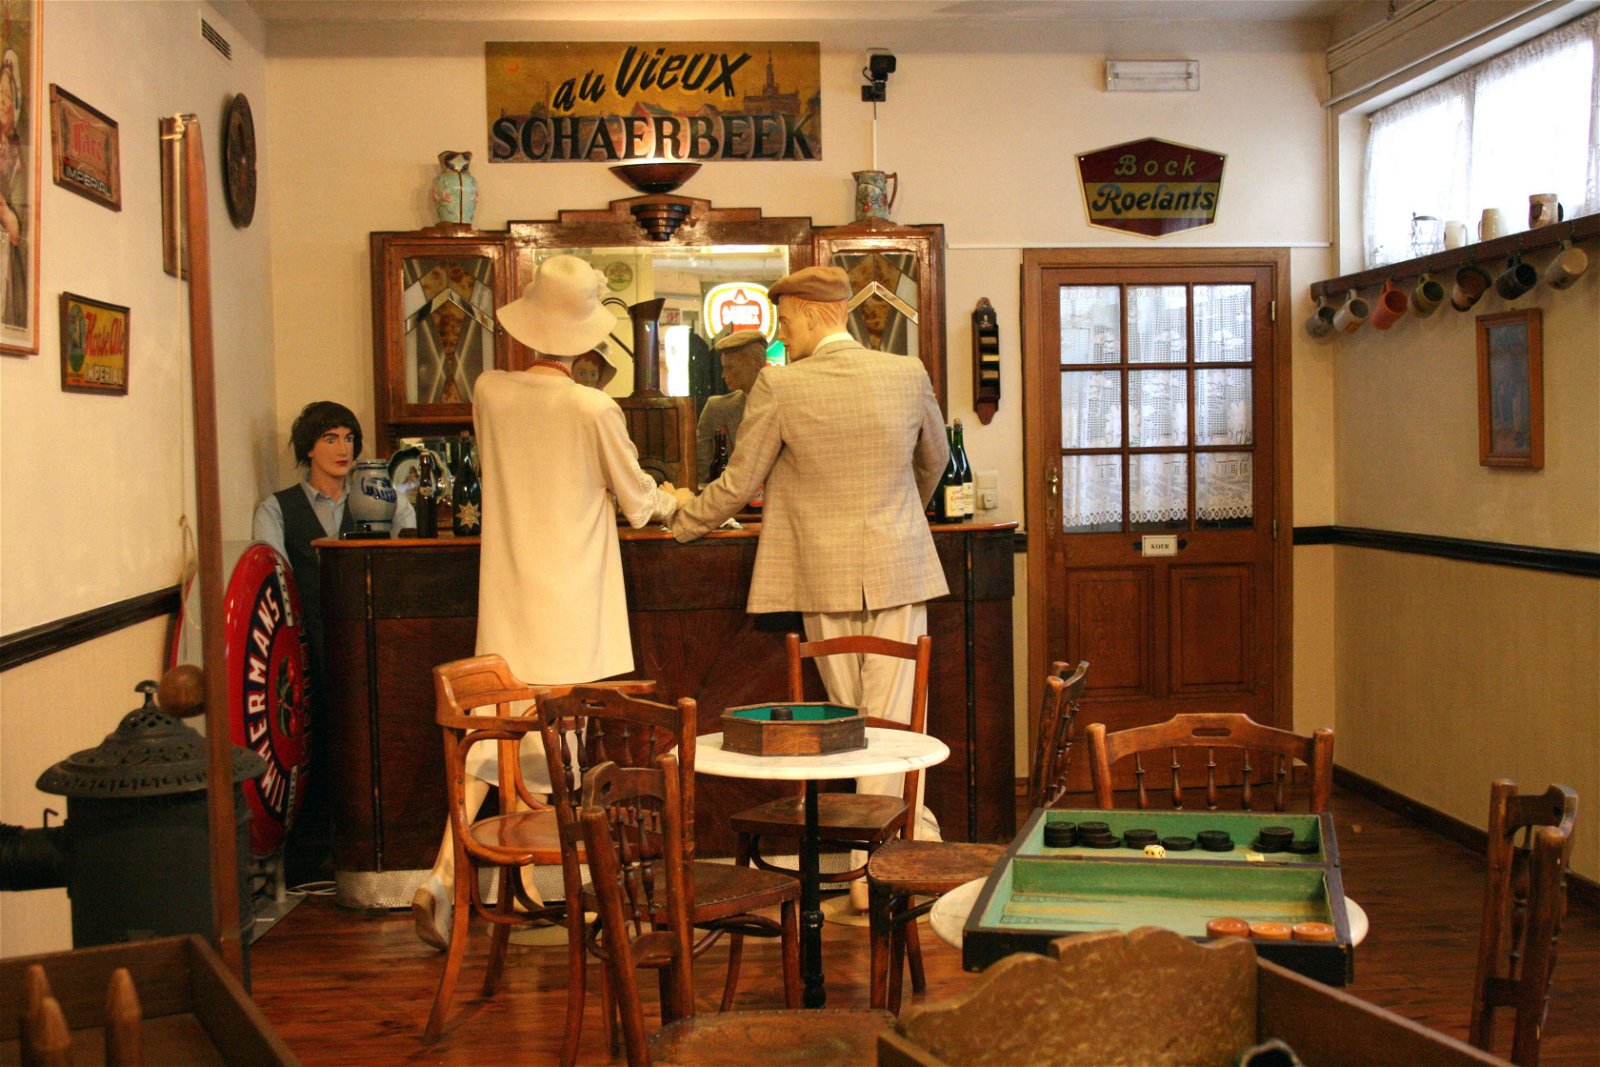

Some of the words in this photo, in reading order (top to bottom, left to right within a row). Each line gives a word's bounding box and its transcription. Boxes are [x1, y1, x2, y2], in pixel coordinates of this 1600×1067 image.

[552, 70, 606, 111] au
[615, 46, 753, 97] Vieux
[491, 114, 816, 160] SCHAERBEEK
[1113, 154, 1197, 177] Bock
[66, 166, 113, 196] IMPERIAL
[1091, 184, 1216, 215] Roelants
[85, 364, 125, 387] IMPERIAL
